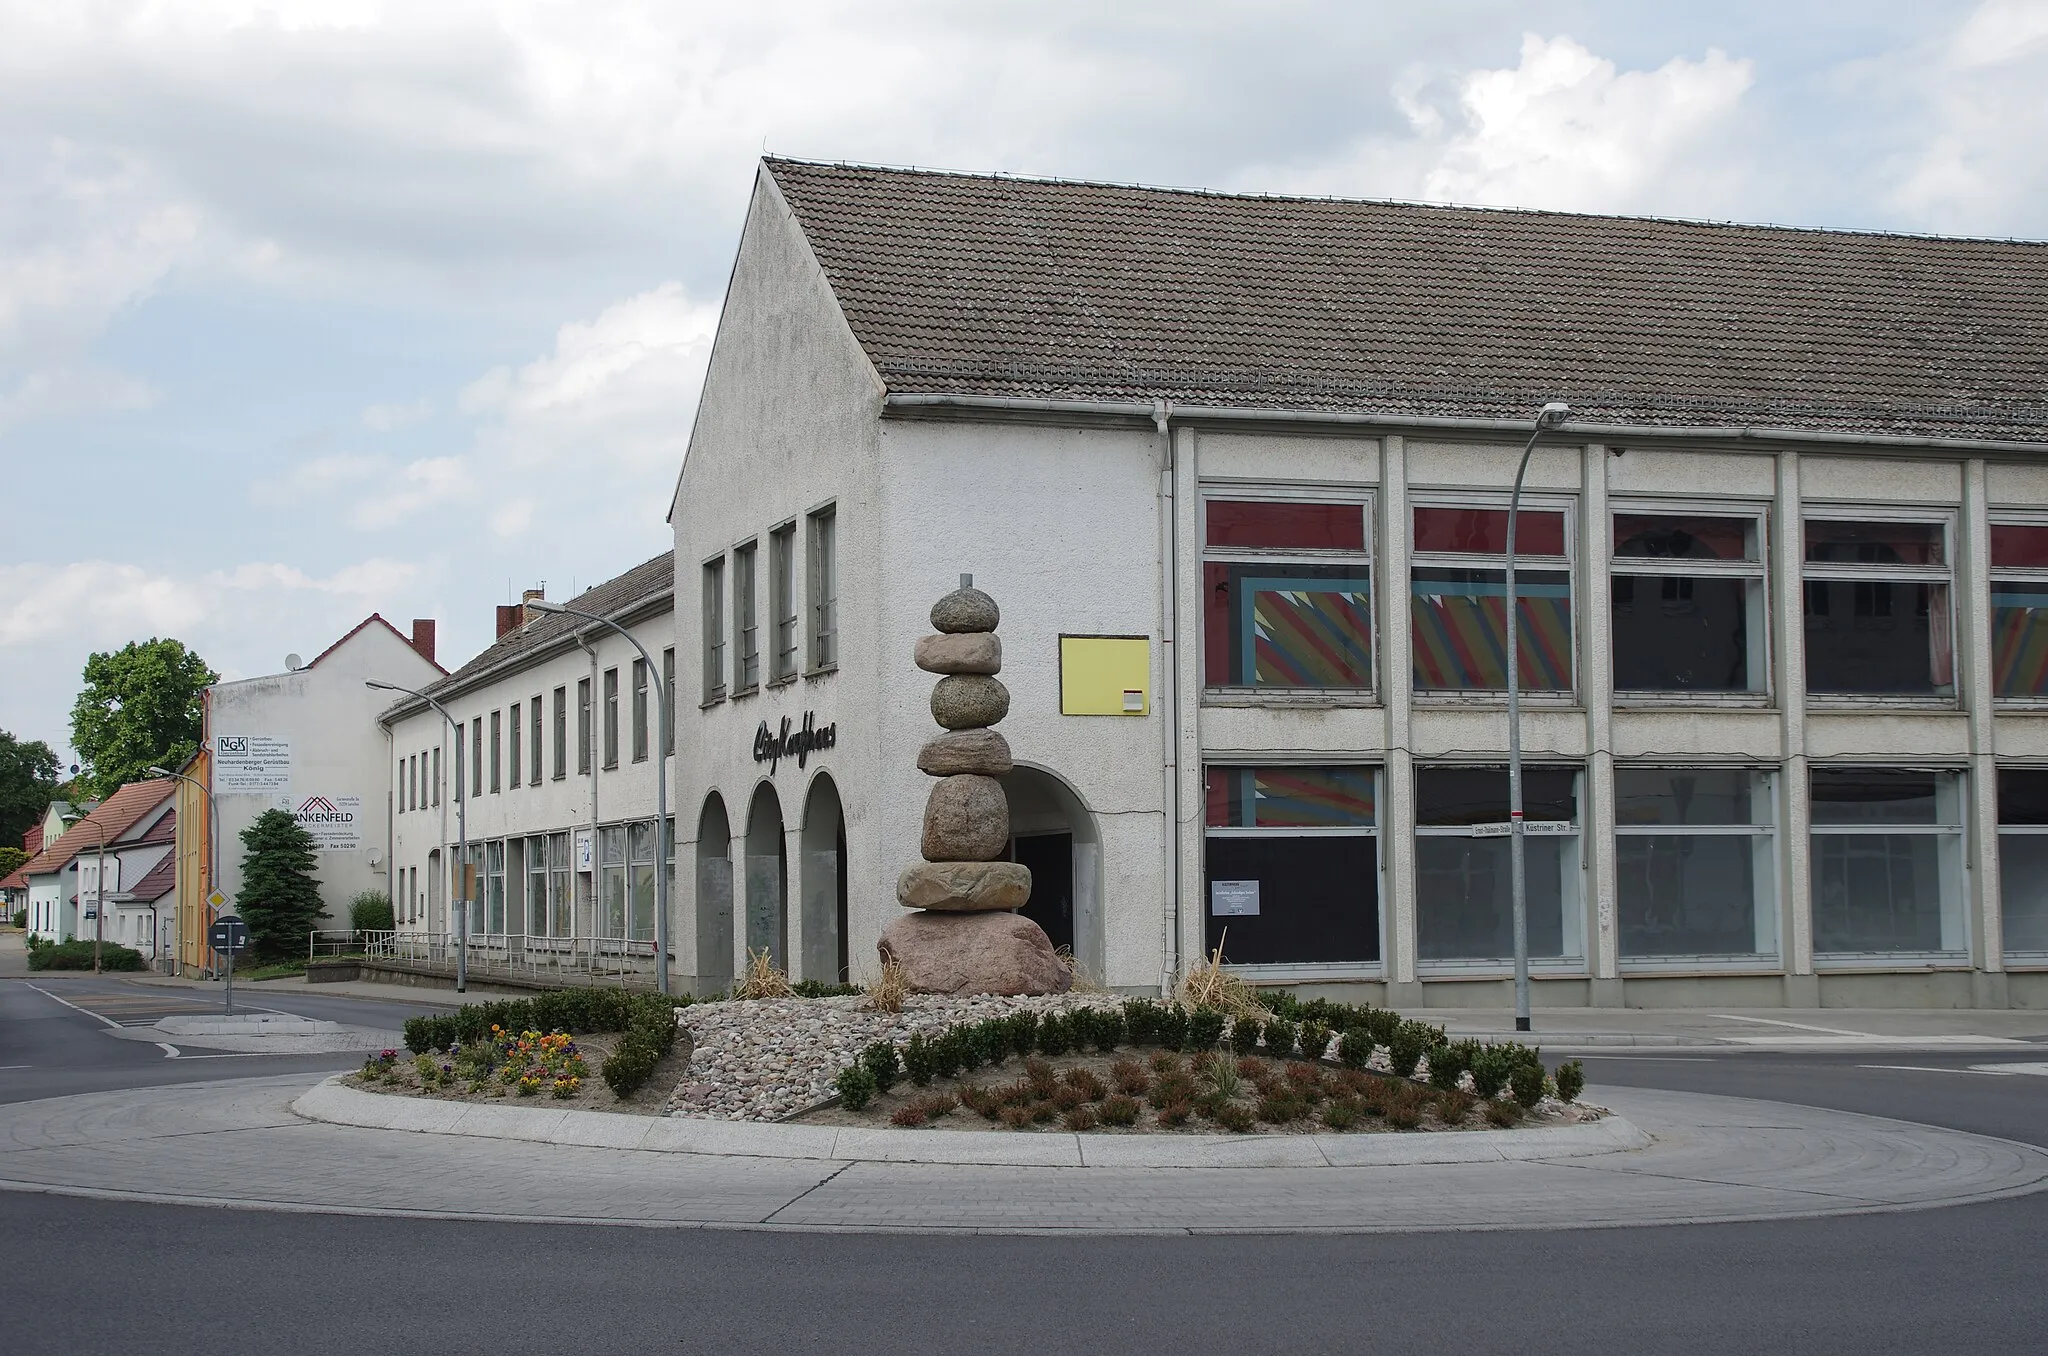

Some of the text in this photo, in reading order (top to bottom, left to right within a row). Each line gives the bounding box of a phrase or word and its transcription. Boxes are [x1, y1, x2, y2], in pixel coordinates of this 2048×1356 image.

[220, 737, 245, 751] NGK
[293, 812, 353, 822] ANKENFELD
[1526, 823, 1568, 832] Küstriner Str.
